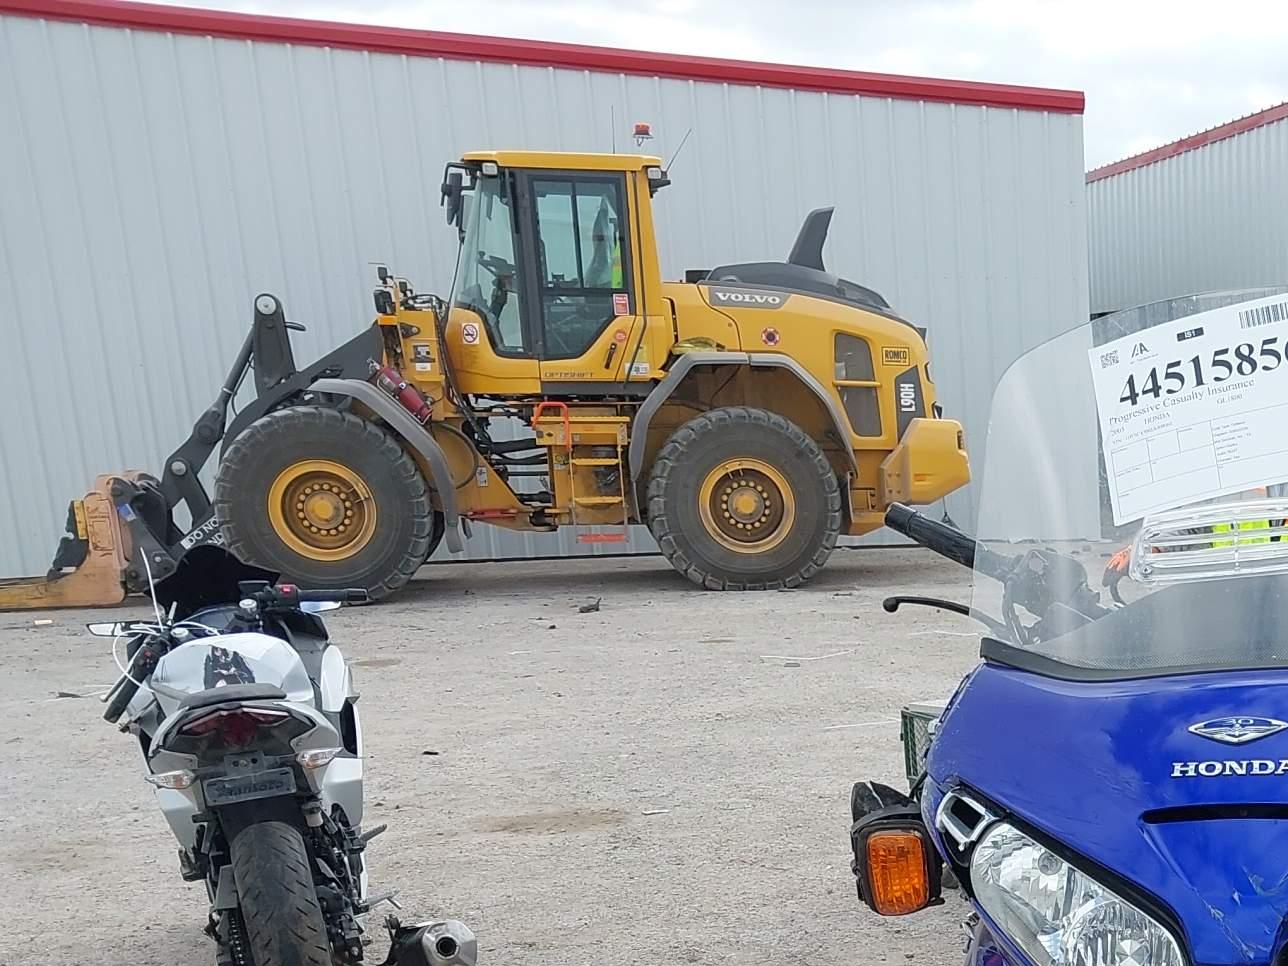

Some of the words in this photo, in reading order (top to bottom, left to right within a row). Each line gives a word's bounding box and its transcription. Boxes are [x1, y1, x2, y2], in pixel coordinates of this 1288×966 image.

[715, 291, 781, 304] VOLVO
[900, 383, 916, 412] L90H
[1109, 402, 1161, 426] Progressive
[1162, 389, 1204, 408] Casualty
[1207, 379, 1255, 396] Insurance
[202, 518, 219, 533] NO
